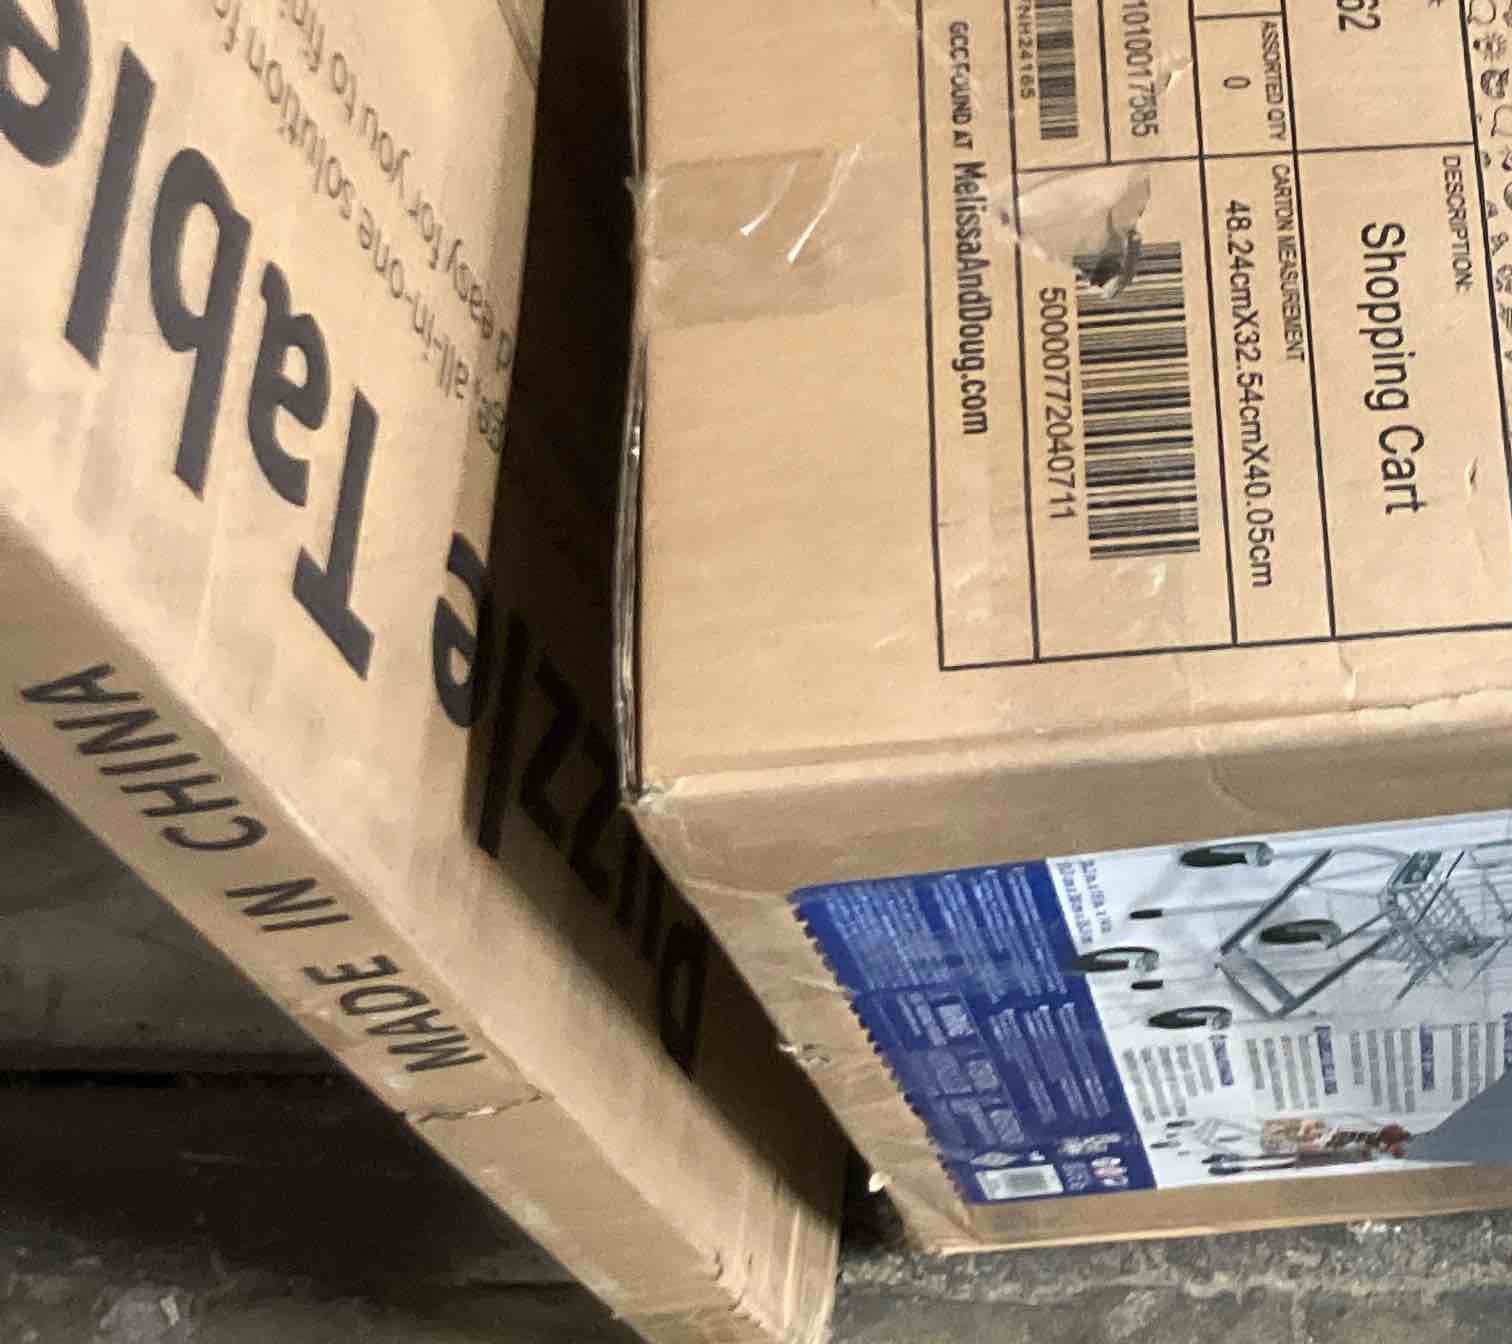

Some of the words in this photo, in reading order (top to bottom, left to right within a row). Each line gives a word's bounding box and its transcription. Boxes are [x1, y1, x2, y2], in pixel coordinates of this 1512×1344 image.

[331, 50, 357, 133] to
[1223, 76, 1251, 91] 0
[1260, 19, 1284, 105] ASSORTED
[243, 43, 354, 223] solution
[359, 105, 411, 205] you
[953, 129, 974, 151] AT
[1266, 108, 1287, 142] QTY
[405, 186, 443, 272] for
[1272, 163, 1298, 233] CARTON
[1442, 156, 1475, 292] DESCRIPTION:
[950, 161, 993, 436] MelissaAndDoug.com
[1275, 234, 1305, 364] MEASUREMENT
[1356, 221, 1418, 412] Shopping
[1038, 286, 1078, 521] 50000772040711
[1224, 199, 1277, 588] 48.24cmX32.54cmX40.05cm
[1377, 424, 1428, 516] Cart
[19, 663, 268, 852] CHINA
[224, 876, 353, 934] IN
[302, 953, 488, 1074] MADE
